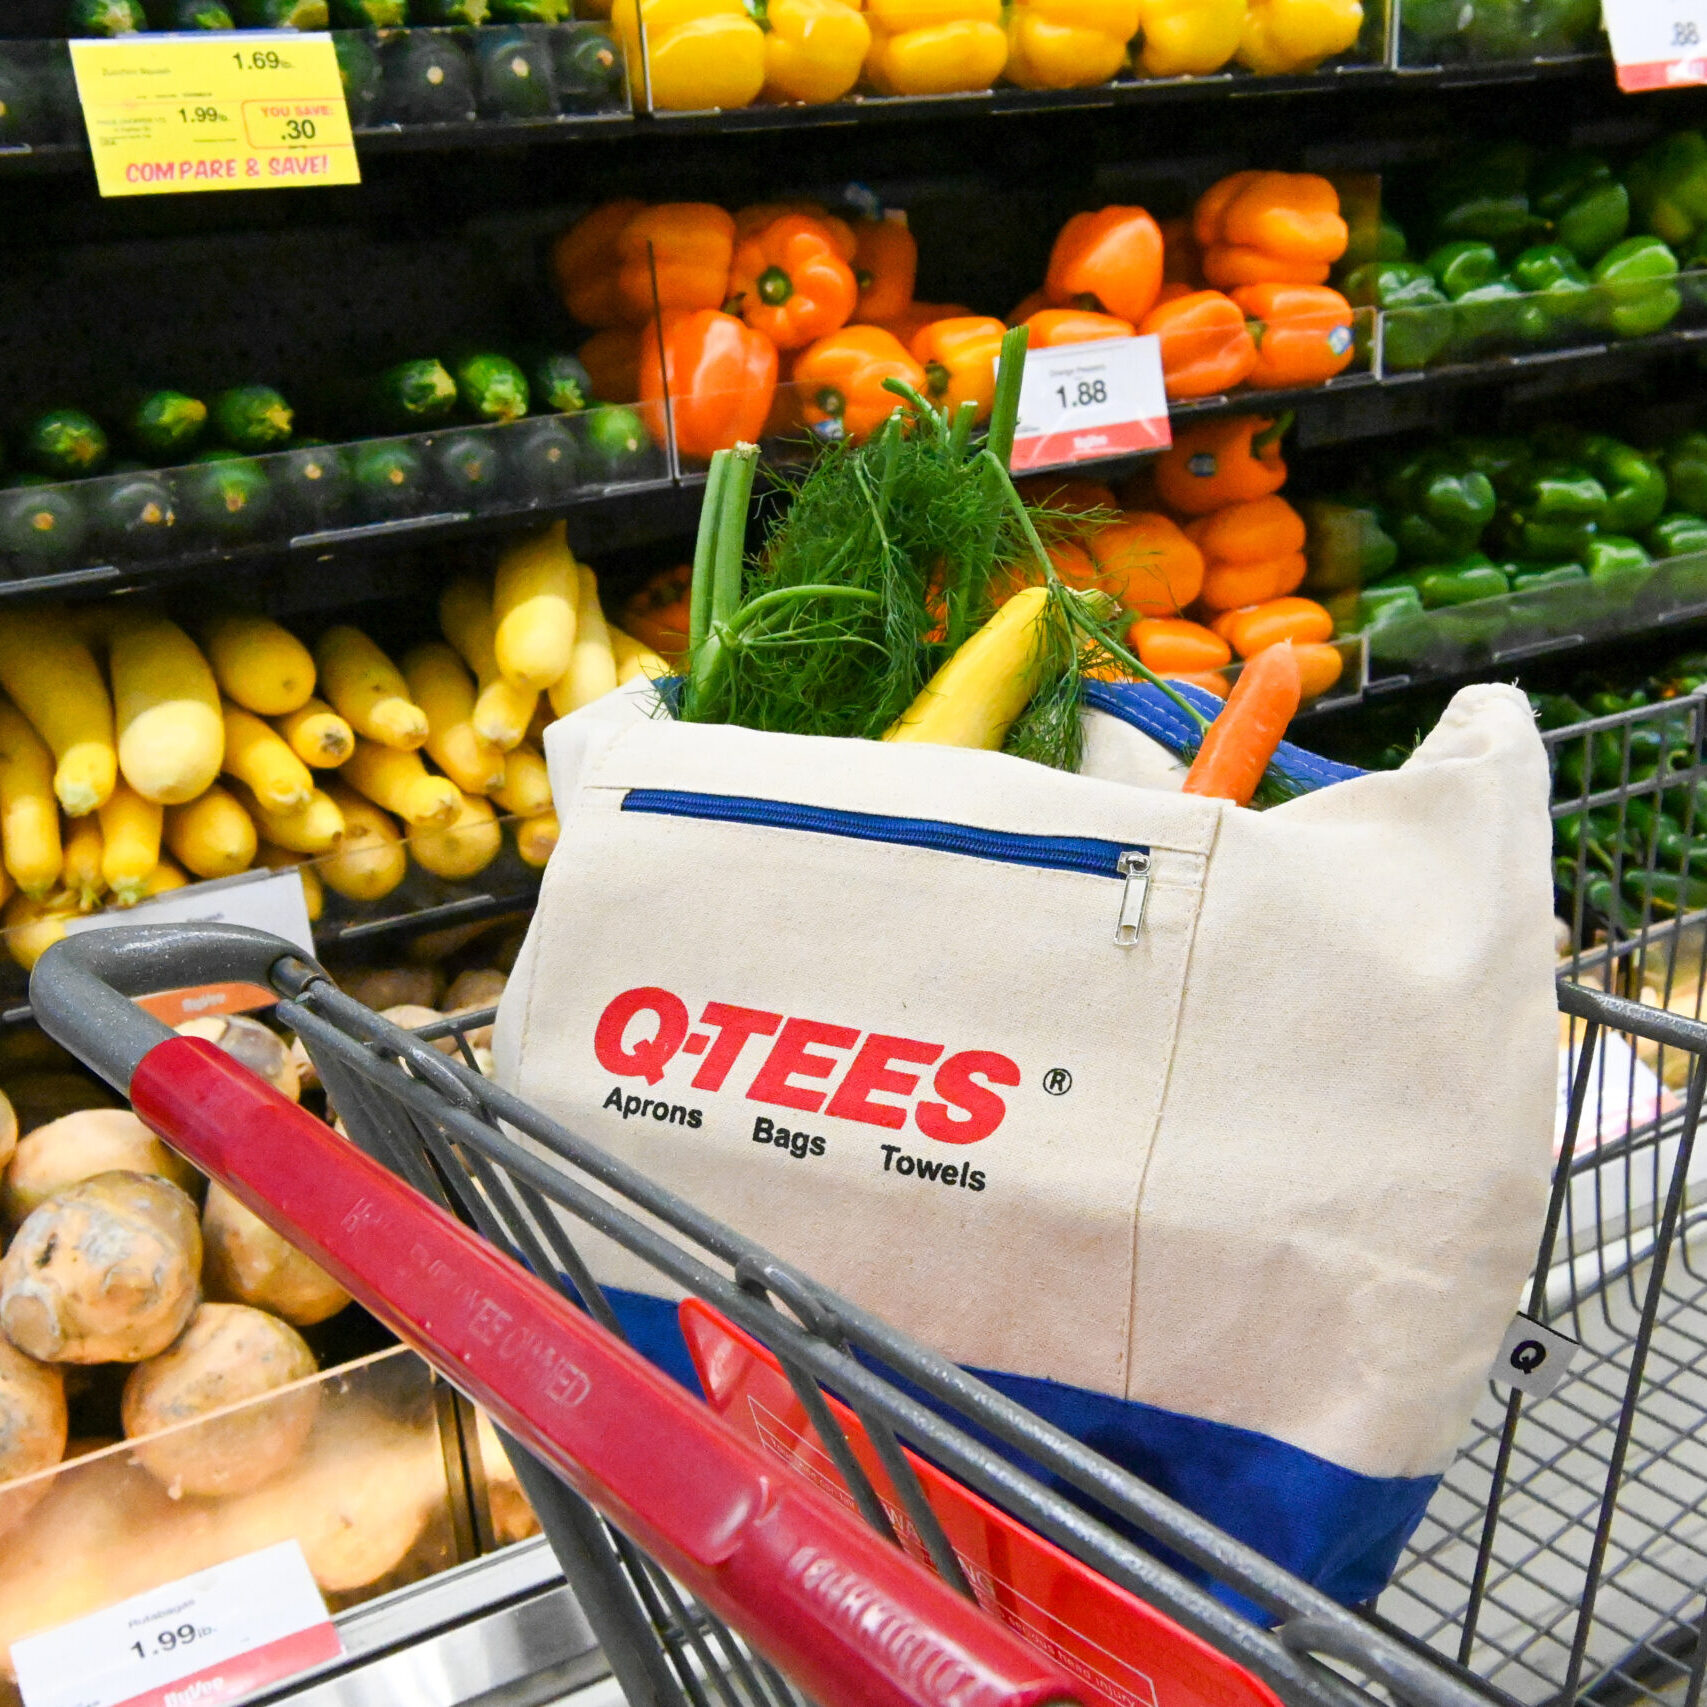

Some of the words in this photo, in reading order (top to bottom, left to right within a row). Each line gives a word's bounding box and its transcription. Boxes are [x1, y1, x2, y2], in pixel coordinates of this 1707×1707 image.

[260, 106, 289, 118] YOU
[281, 119, 316, 141] .30
[246, 159, 260, 177] &
[268, 154, 328, 177] SAVE!
[1056, 380, 1107, 408] 1.88
[594, 987, 1021, 1145] Q-TEES
[602, 1086, 703, 1128] Aprons
[752, 1116, 827, 1159] Bags
[880, 1144, 986, 1192] Towels
[1510, 1340, 1547, 1375] Q
